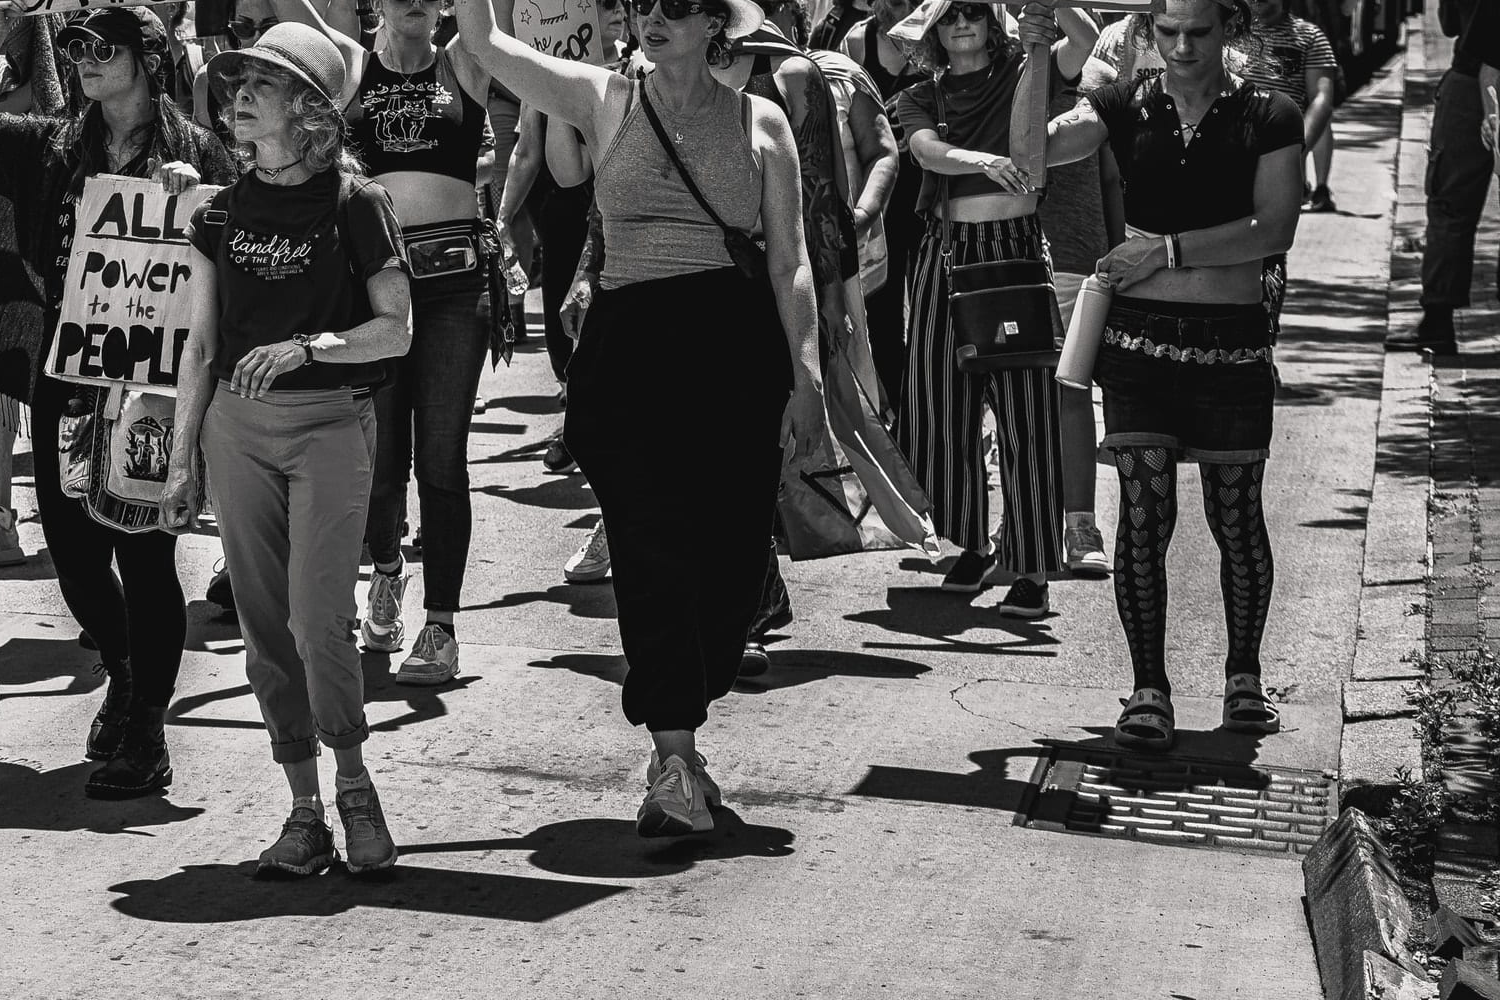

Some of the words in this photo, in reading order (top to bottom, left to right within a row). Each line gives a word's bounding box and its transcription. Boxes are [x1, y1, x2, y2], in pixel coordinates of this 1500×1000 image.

[91, 192, 190, 240] ALL
[235, 255, 248, 264] OF
[252, 256, 268, 264] THE
[88, 294, 110, 317] to
[125, 294, 156, 320] the
